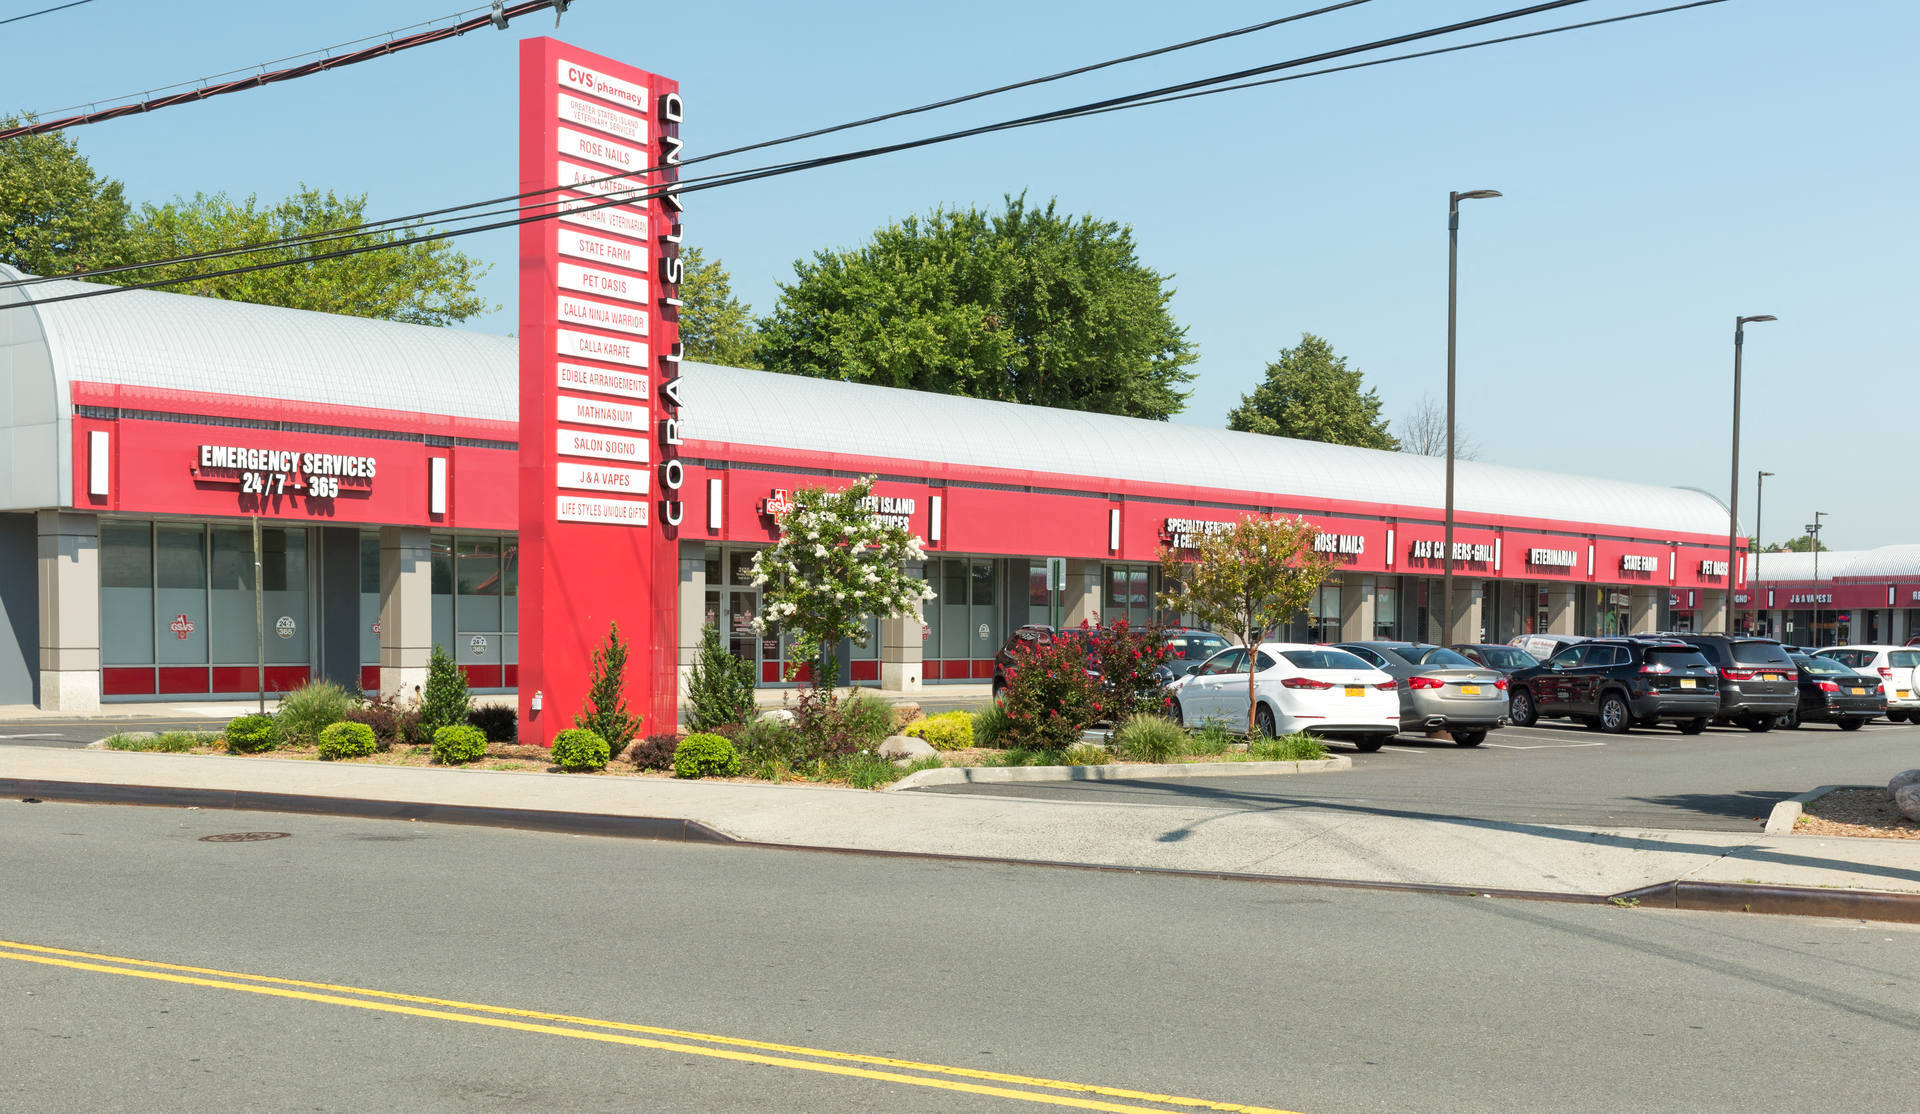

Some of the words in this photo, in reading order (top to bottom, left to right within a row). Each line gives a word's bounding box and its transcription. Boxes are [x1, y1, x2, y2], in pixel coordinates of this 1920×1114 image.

[570, 101, 595, 115] GREATER
[597, 109, 617, 122] STATEN
[619, 115, 639, 129] ISLAND
[573, 110, 608, 127] VETERINARY
[610, 122, 635, 137] SERVICES
[580, 139, 602, 157] ROSE
[606, 147, 629, 165] NAILS
[666, 93, 684, 306] ISLAND
[609, 214, 647, 233] VETERINARIAN
[579, 240, 604, 256] STATE
[607, 246, 631, 262] FARM
[583, 274, 599, 288] PET
[602, 277, 627, 293] OASIS
[564, 302, 587, 318] CALLA
[589, 308, 609, 323] NINJA
[612, 312, 644, 328] WARRIOR
[579, 338, 602, 354] CALLA
[604, 343, 630, 358] KARATE
[561, 369, 587, 384] EDIBLE
[589, 373, 647, 392] ARRANGEMENTS
[577, 405, 633, 423] MATHNASIUM
[666, 343, 684, 526] CORAL
[574, 437, 602, 451] SALON
[606, 440, 635, 455] SOGNO
[201, 445, 300, 472] EMERGENCY
[302, 453, 376, 478] SERVICES
[309, 476, 338, 498] 365
[602, 473, 630, 486] VAPES
[562, 502, 575, 515] LIFE
[578, 503, 601, 516] STYLES
[603, 505, 627, 518] UNIQUE
[629, 507, 646, 519] GIFTS
[881, 496, 915, 515] ISLAND
[1168, 518, 1204, 533] SPECIALTY
[1314, 534, 1337, 552] ROSE
[1340, 535, 1365, 554] NAILS
[1414, 540, 1431, 558] A&S
[1531, 548, 1577, 567] VETERINARIAN
[1624, 555, 1641, 570] STATE
[1642, 556, 1658, 571] FARM
[1703, 560, 1713, 575] PET
[1714, 561, 1728, 576] OASIS
